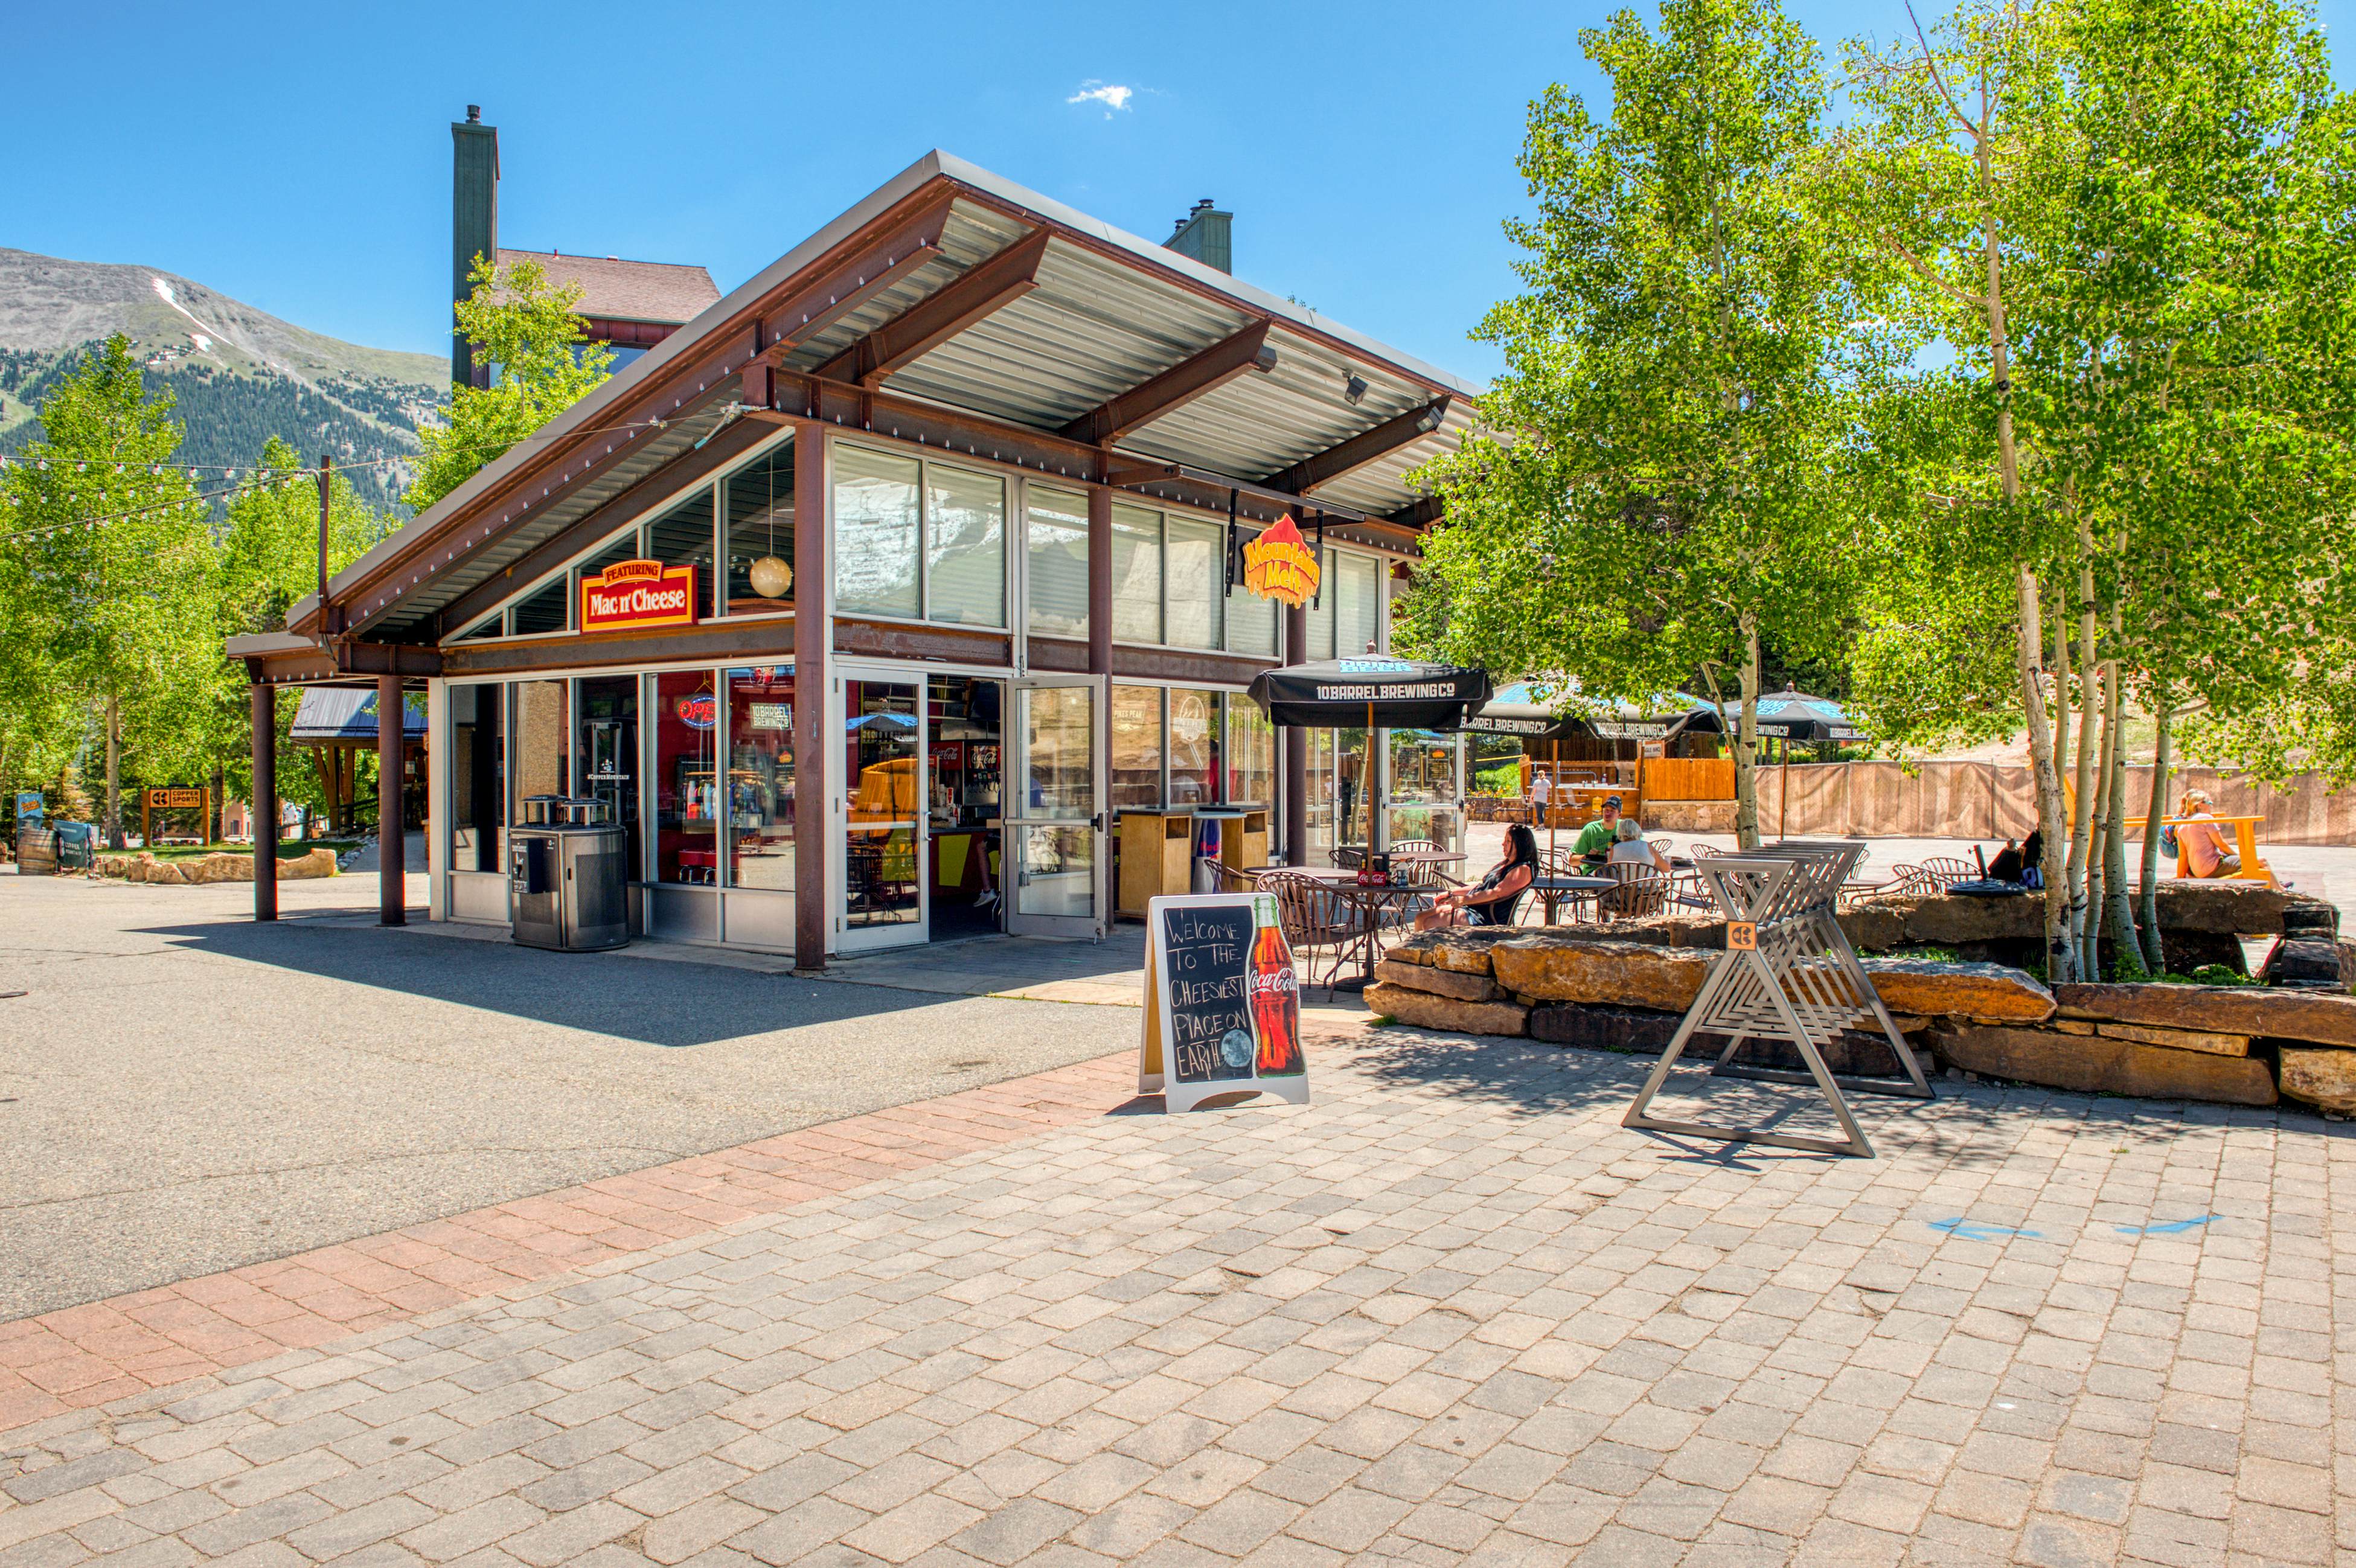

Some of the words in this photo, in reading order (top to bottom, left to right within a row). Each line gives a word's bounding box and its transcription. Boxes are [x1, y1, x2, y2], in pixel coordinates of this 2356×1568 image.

[606, 564, 659, 581] FEATURING
[1244, 538, 1320, 586] Mountain
[1264, 561, 1301, 595] Melt
[591, 594, 618, 616] Mac
[632, 587, 686, 613] Cheese
[679, 700, 715, 721] OPE
[1167, 947, 1197, 971] TO
[1198, 944, 1241, 966] THE
[1170, 975, 1244, 1007] CHEESIEST
[1249, 967, 1298, 995] Coca-Cola
[1226, 1008, 1247, 1029] ON
[1177, 1038, 1220, 1081] EARTH
